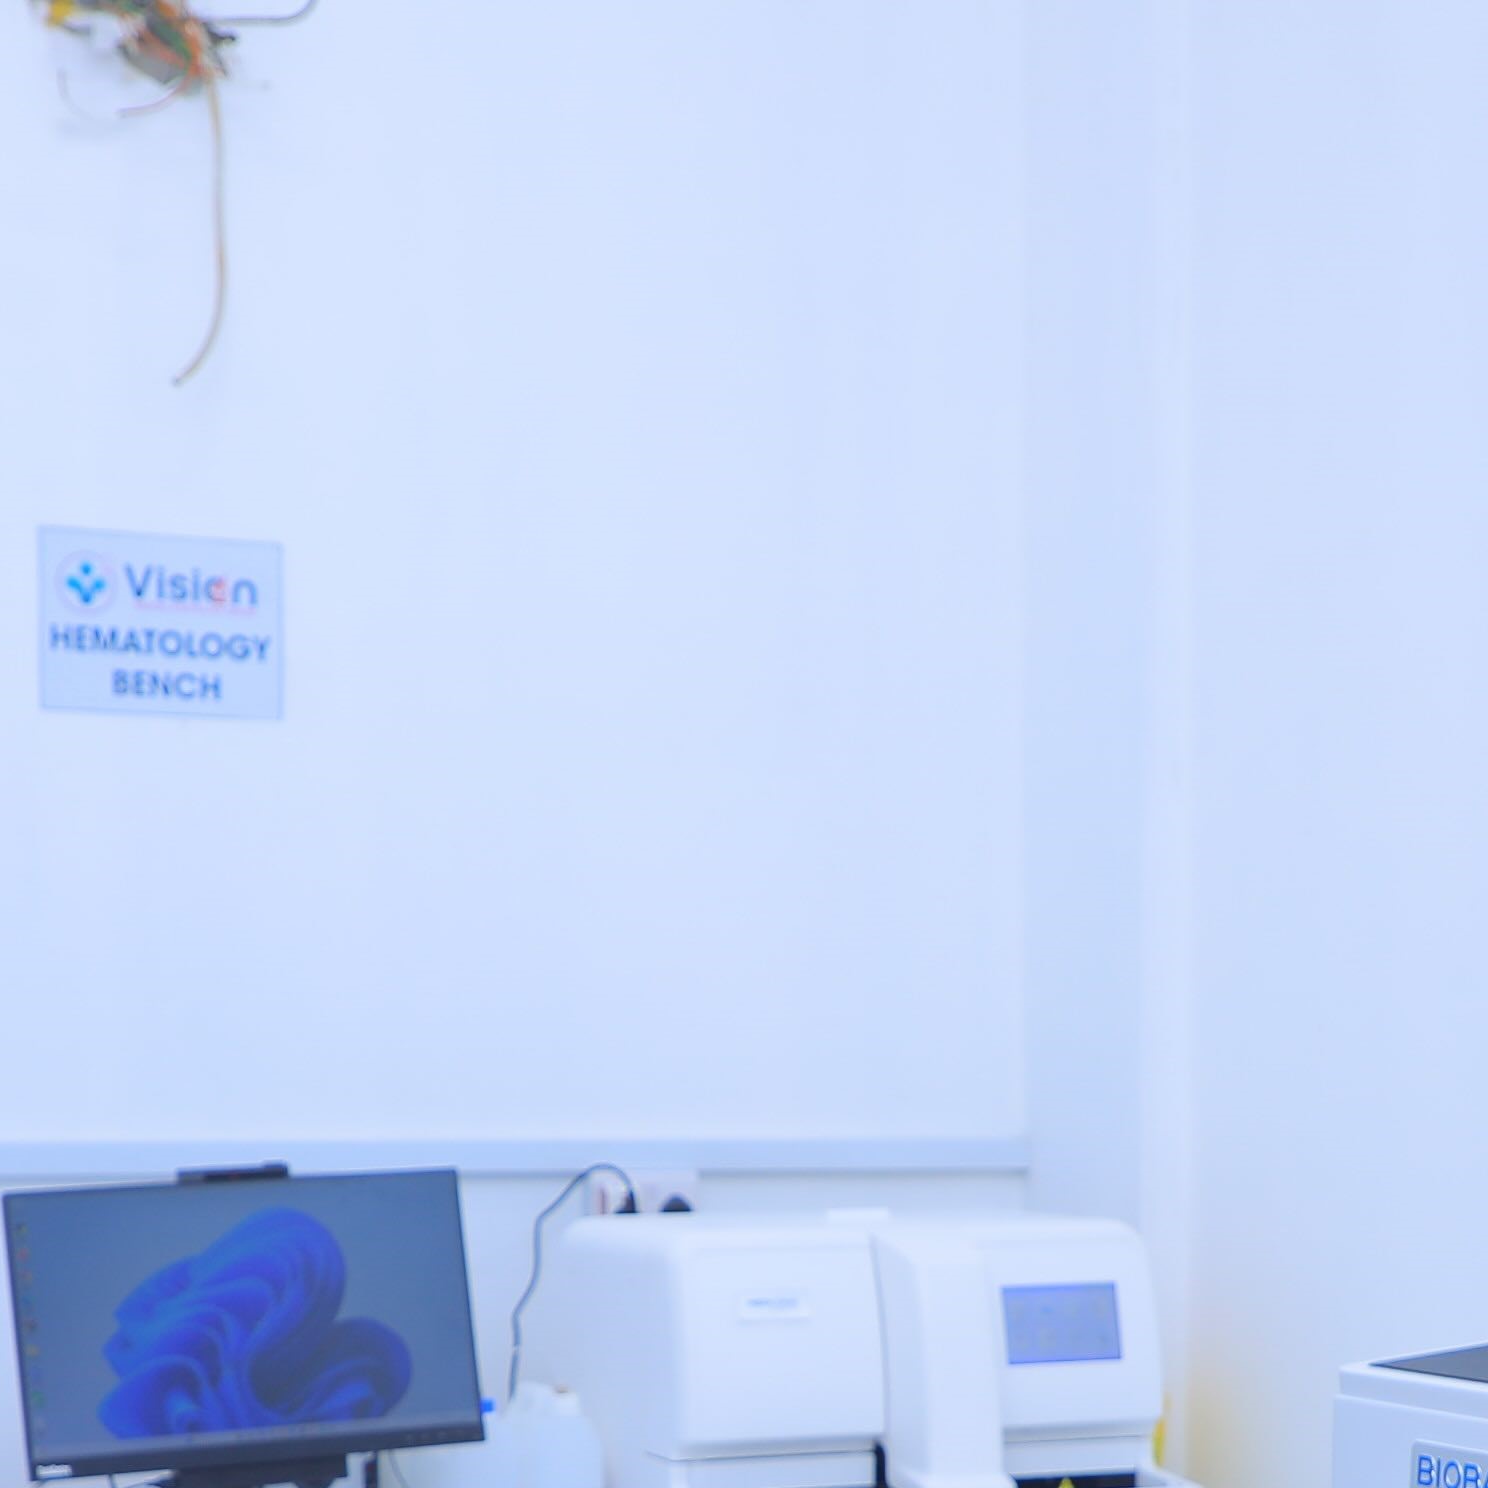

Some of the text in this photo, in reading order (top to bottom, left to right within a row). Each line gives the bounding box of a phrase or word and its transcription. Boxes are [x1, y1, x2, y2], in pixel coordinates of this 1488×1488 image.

[124, 563, 258, 605] Vision
[49, 621, 270, 662] HEMATOLOGY
[112, 667, 221, 700] BENCH
